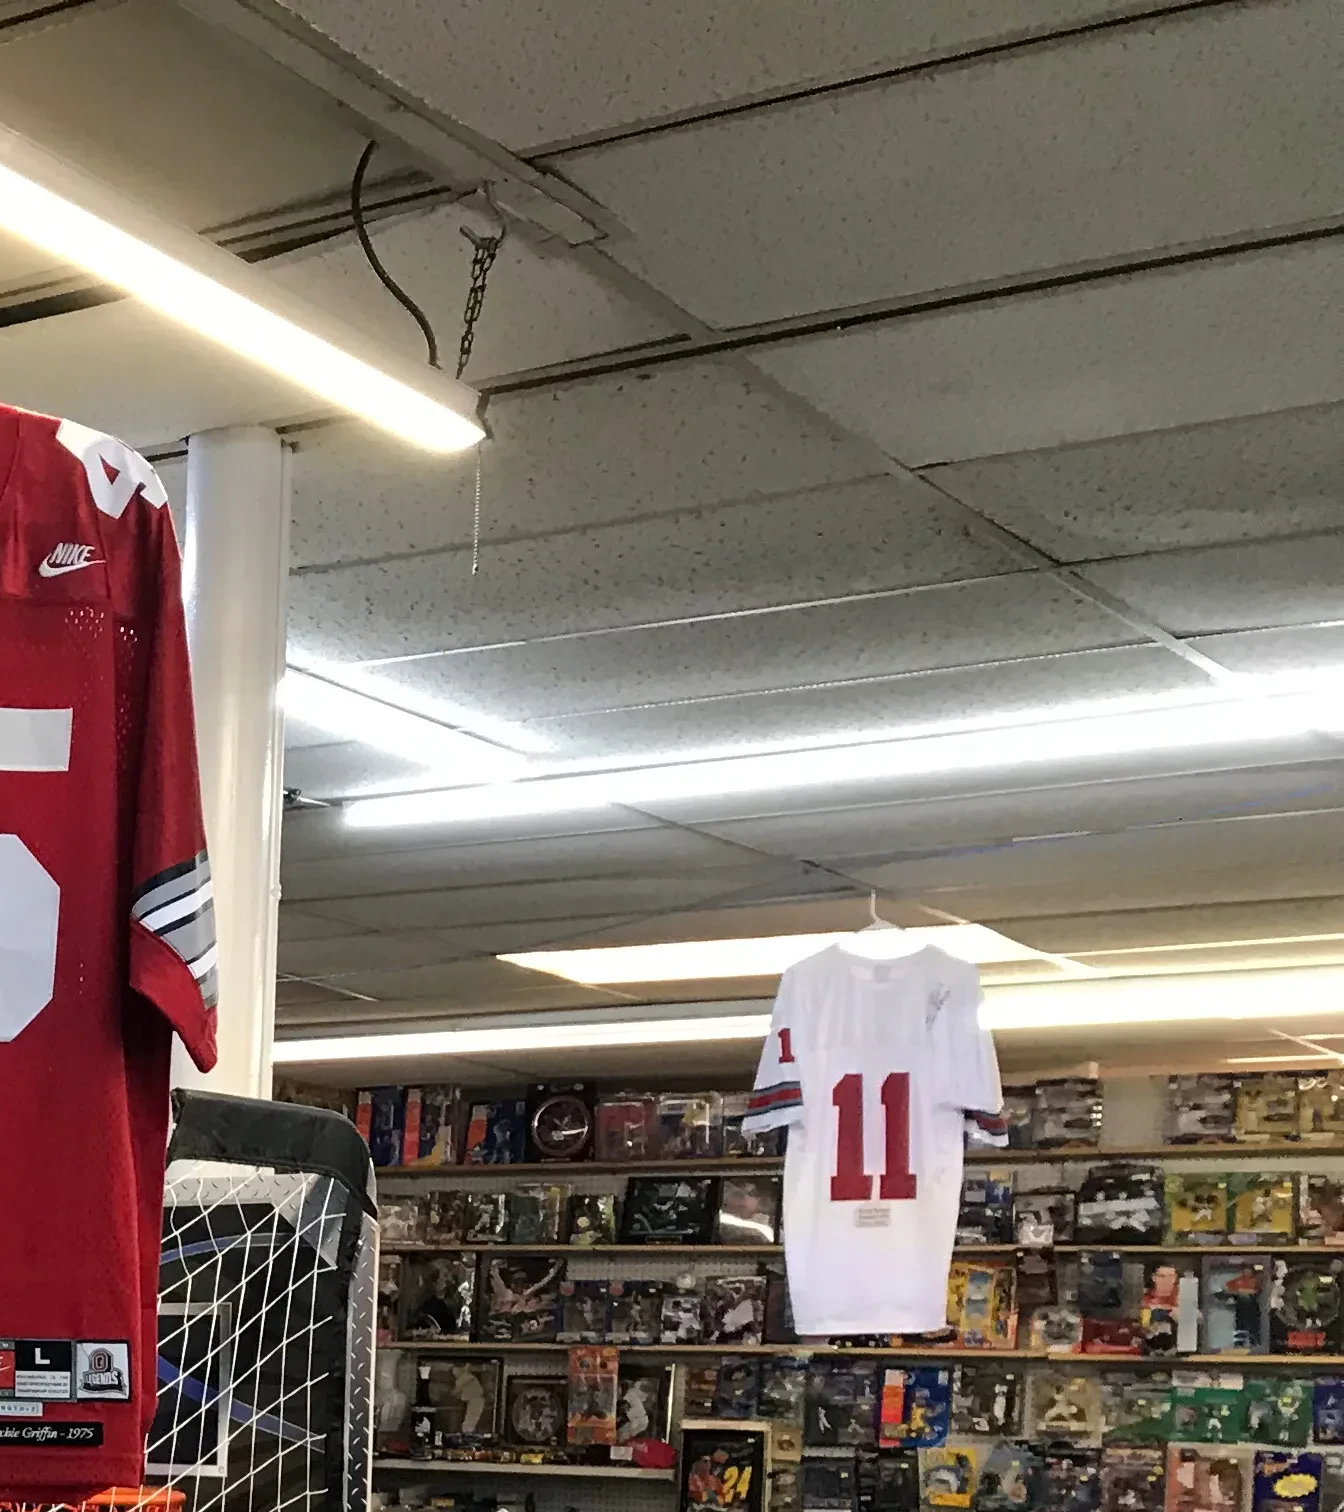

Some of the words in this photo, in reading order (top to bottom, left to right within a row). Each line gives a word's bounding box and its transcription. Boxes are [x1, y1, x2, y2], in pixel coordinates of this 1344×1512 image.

[50, 542, 94, 565] NIKE
[830, 1072, 917, 1201] 11
[34, 1347, 51, 1365] L
[22, 1426, 58, 1442] Griffin
[66, 1427, 94, 1439] 1975
